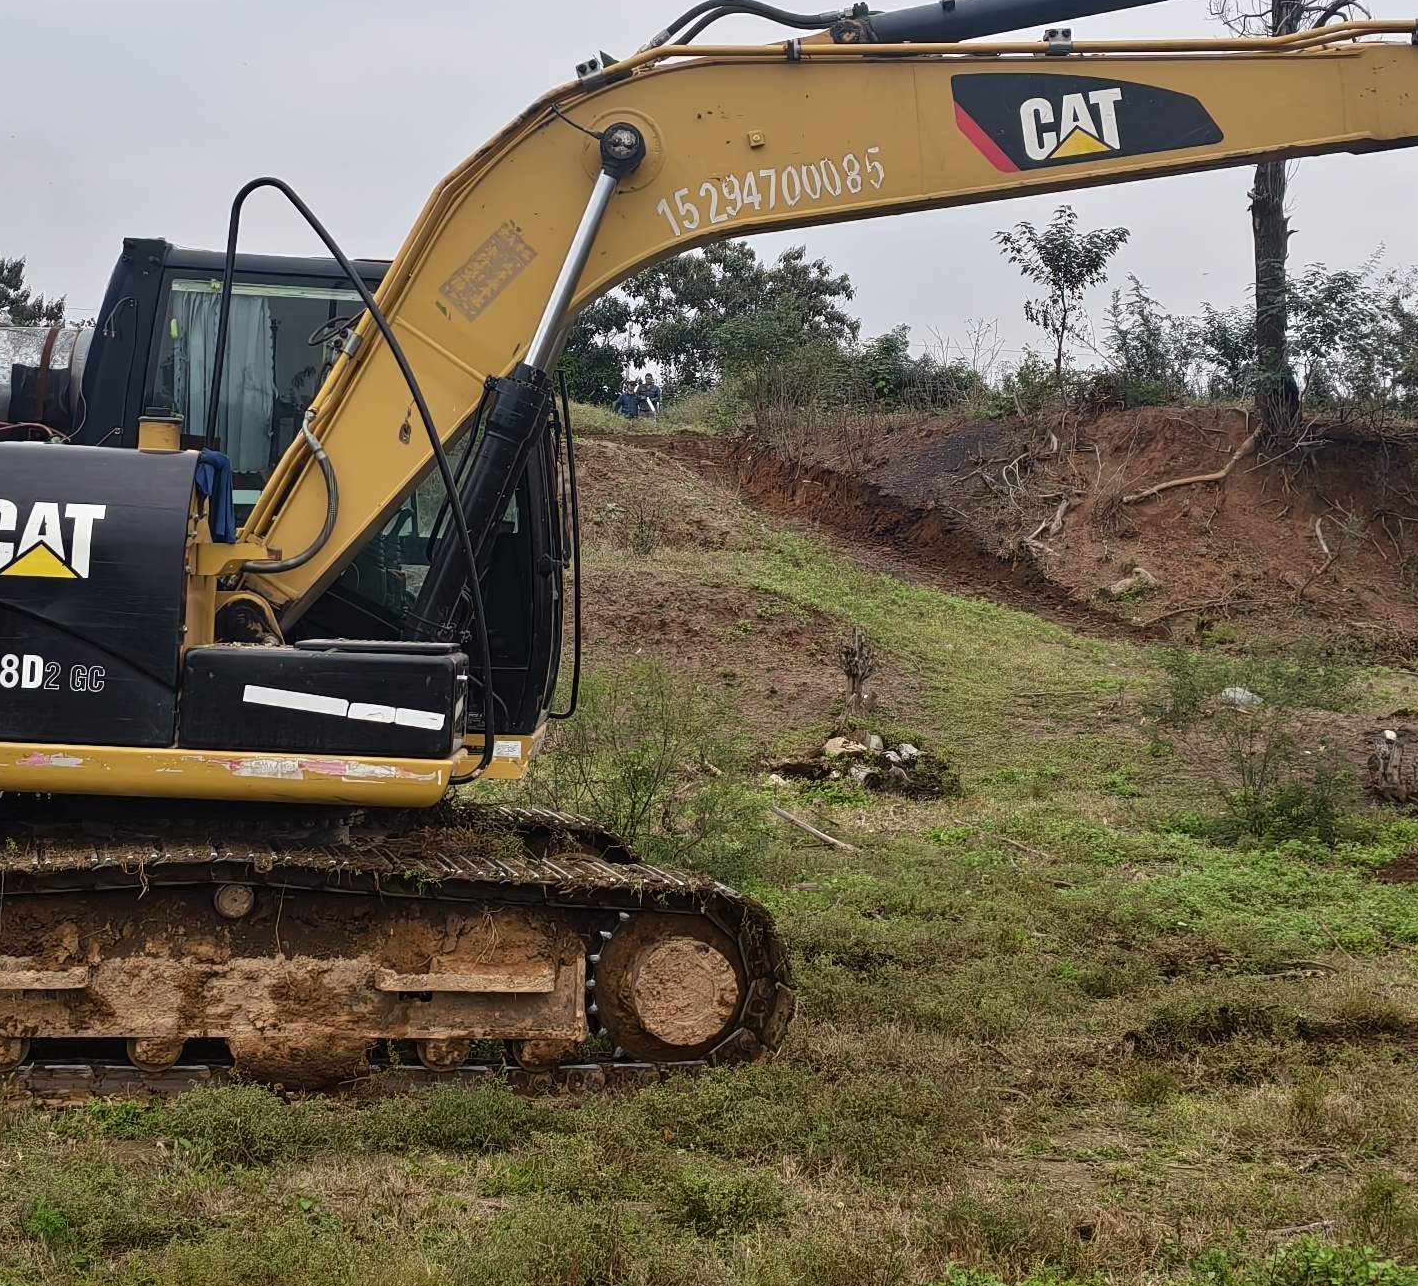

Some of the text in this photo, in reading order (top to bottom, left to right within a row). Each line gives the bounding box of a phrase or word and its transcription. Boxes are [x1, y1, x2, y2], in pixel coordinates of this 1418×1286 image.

[1019, 88, 1123, 161] CAT
[656, 147, 885, 236] 15294700085
[69, 664, 106, 692] GC
